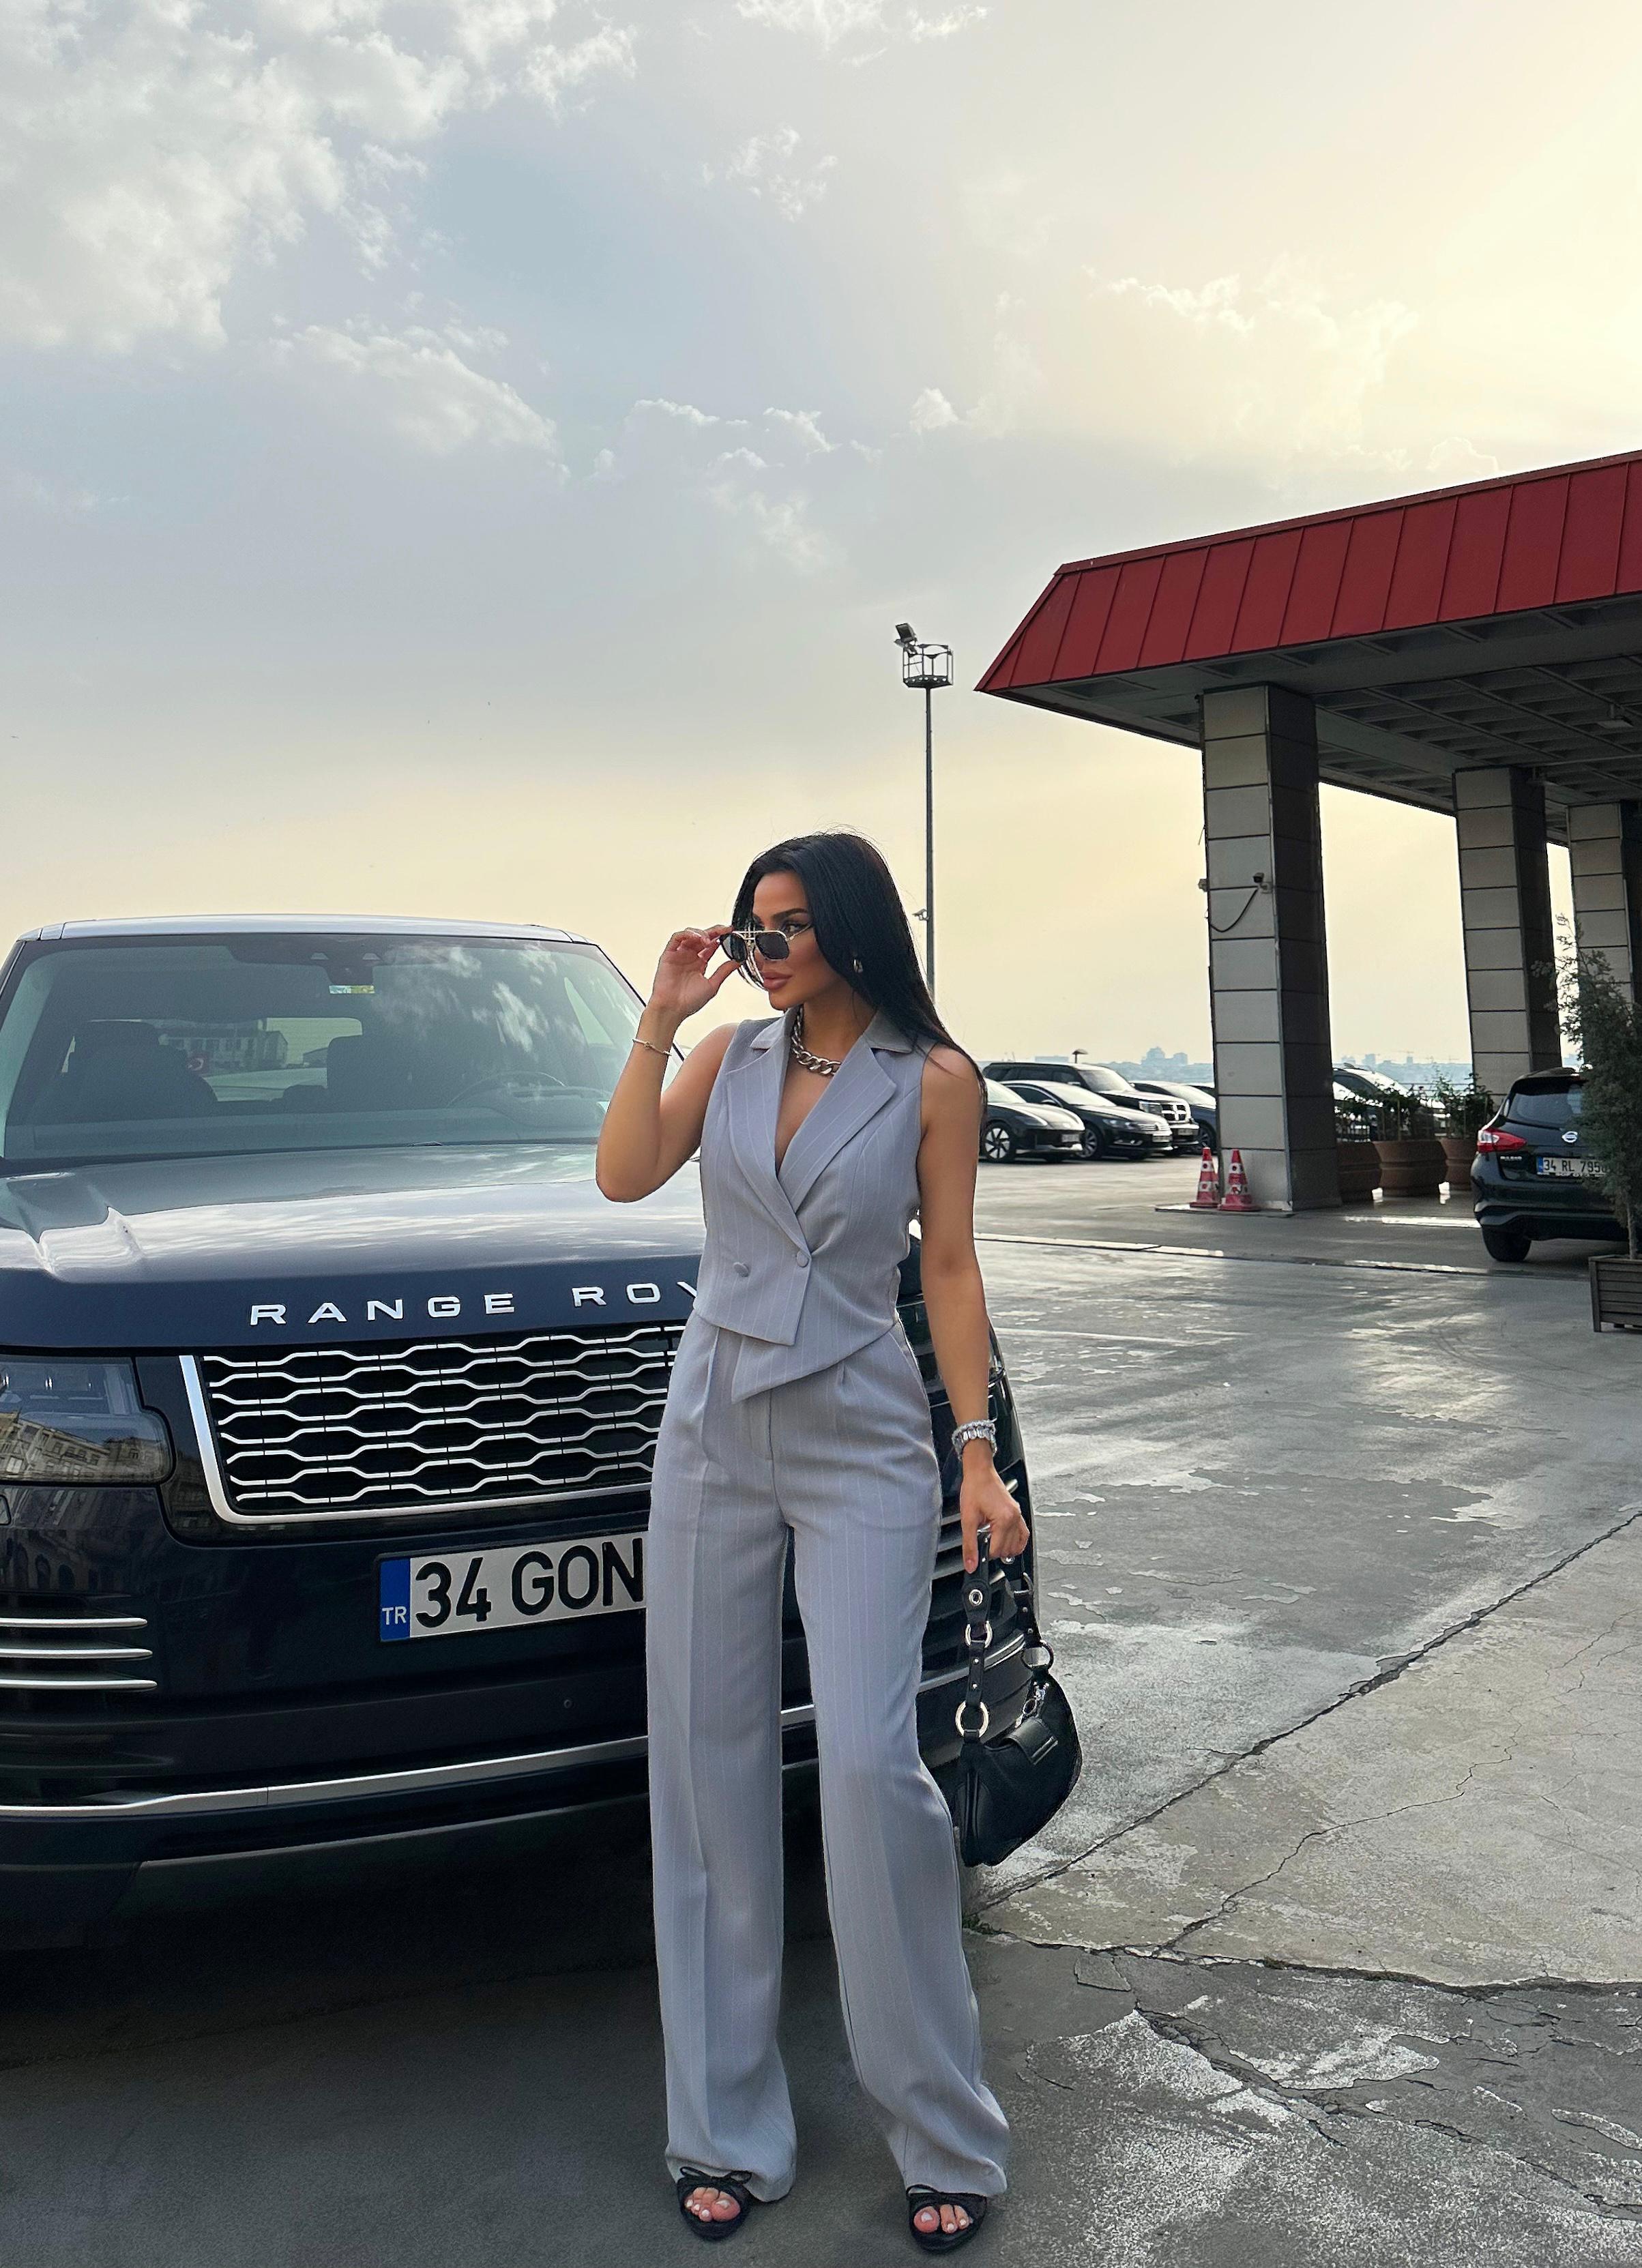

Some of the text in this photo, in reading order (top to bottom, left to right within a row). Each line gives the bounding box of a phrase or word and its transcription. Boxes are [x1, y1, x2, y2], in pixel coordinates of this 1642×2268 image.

[1543, 1160, 1556, 1171] 34
[1562, 1160, 1574, 1172] RL
[249, 1293, 515, 1326] RANGE
[381, 1537, 644, 1628] TR 34 GON
